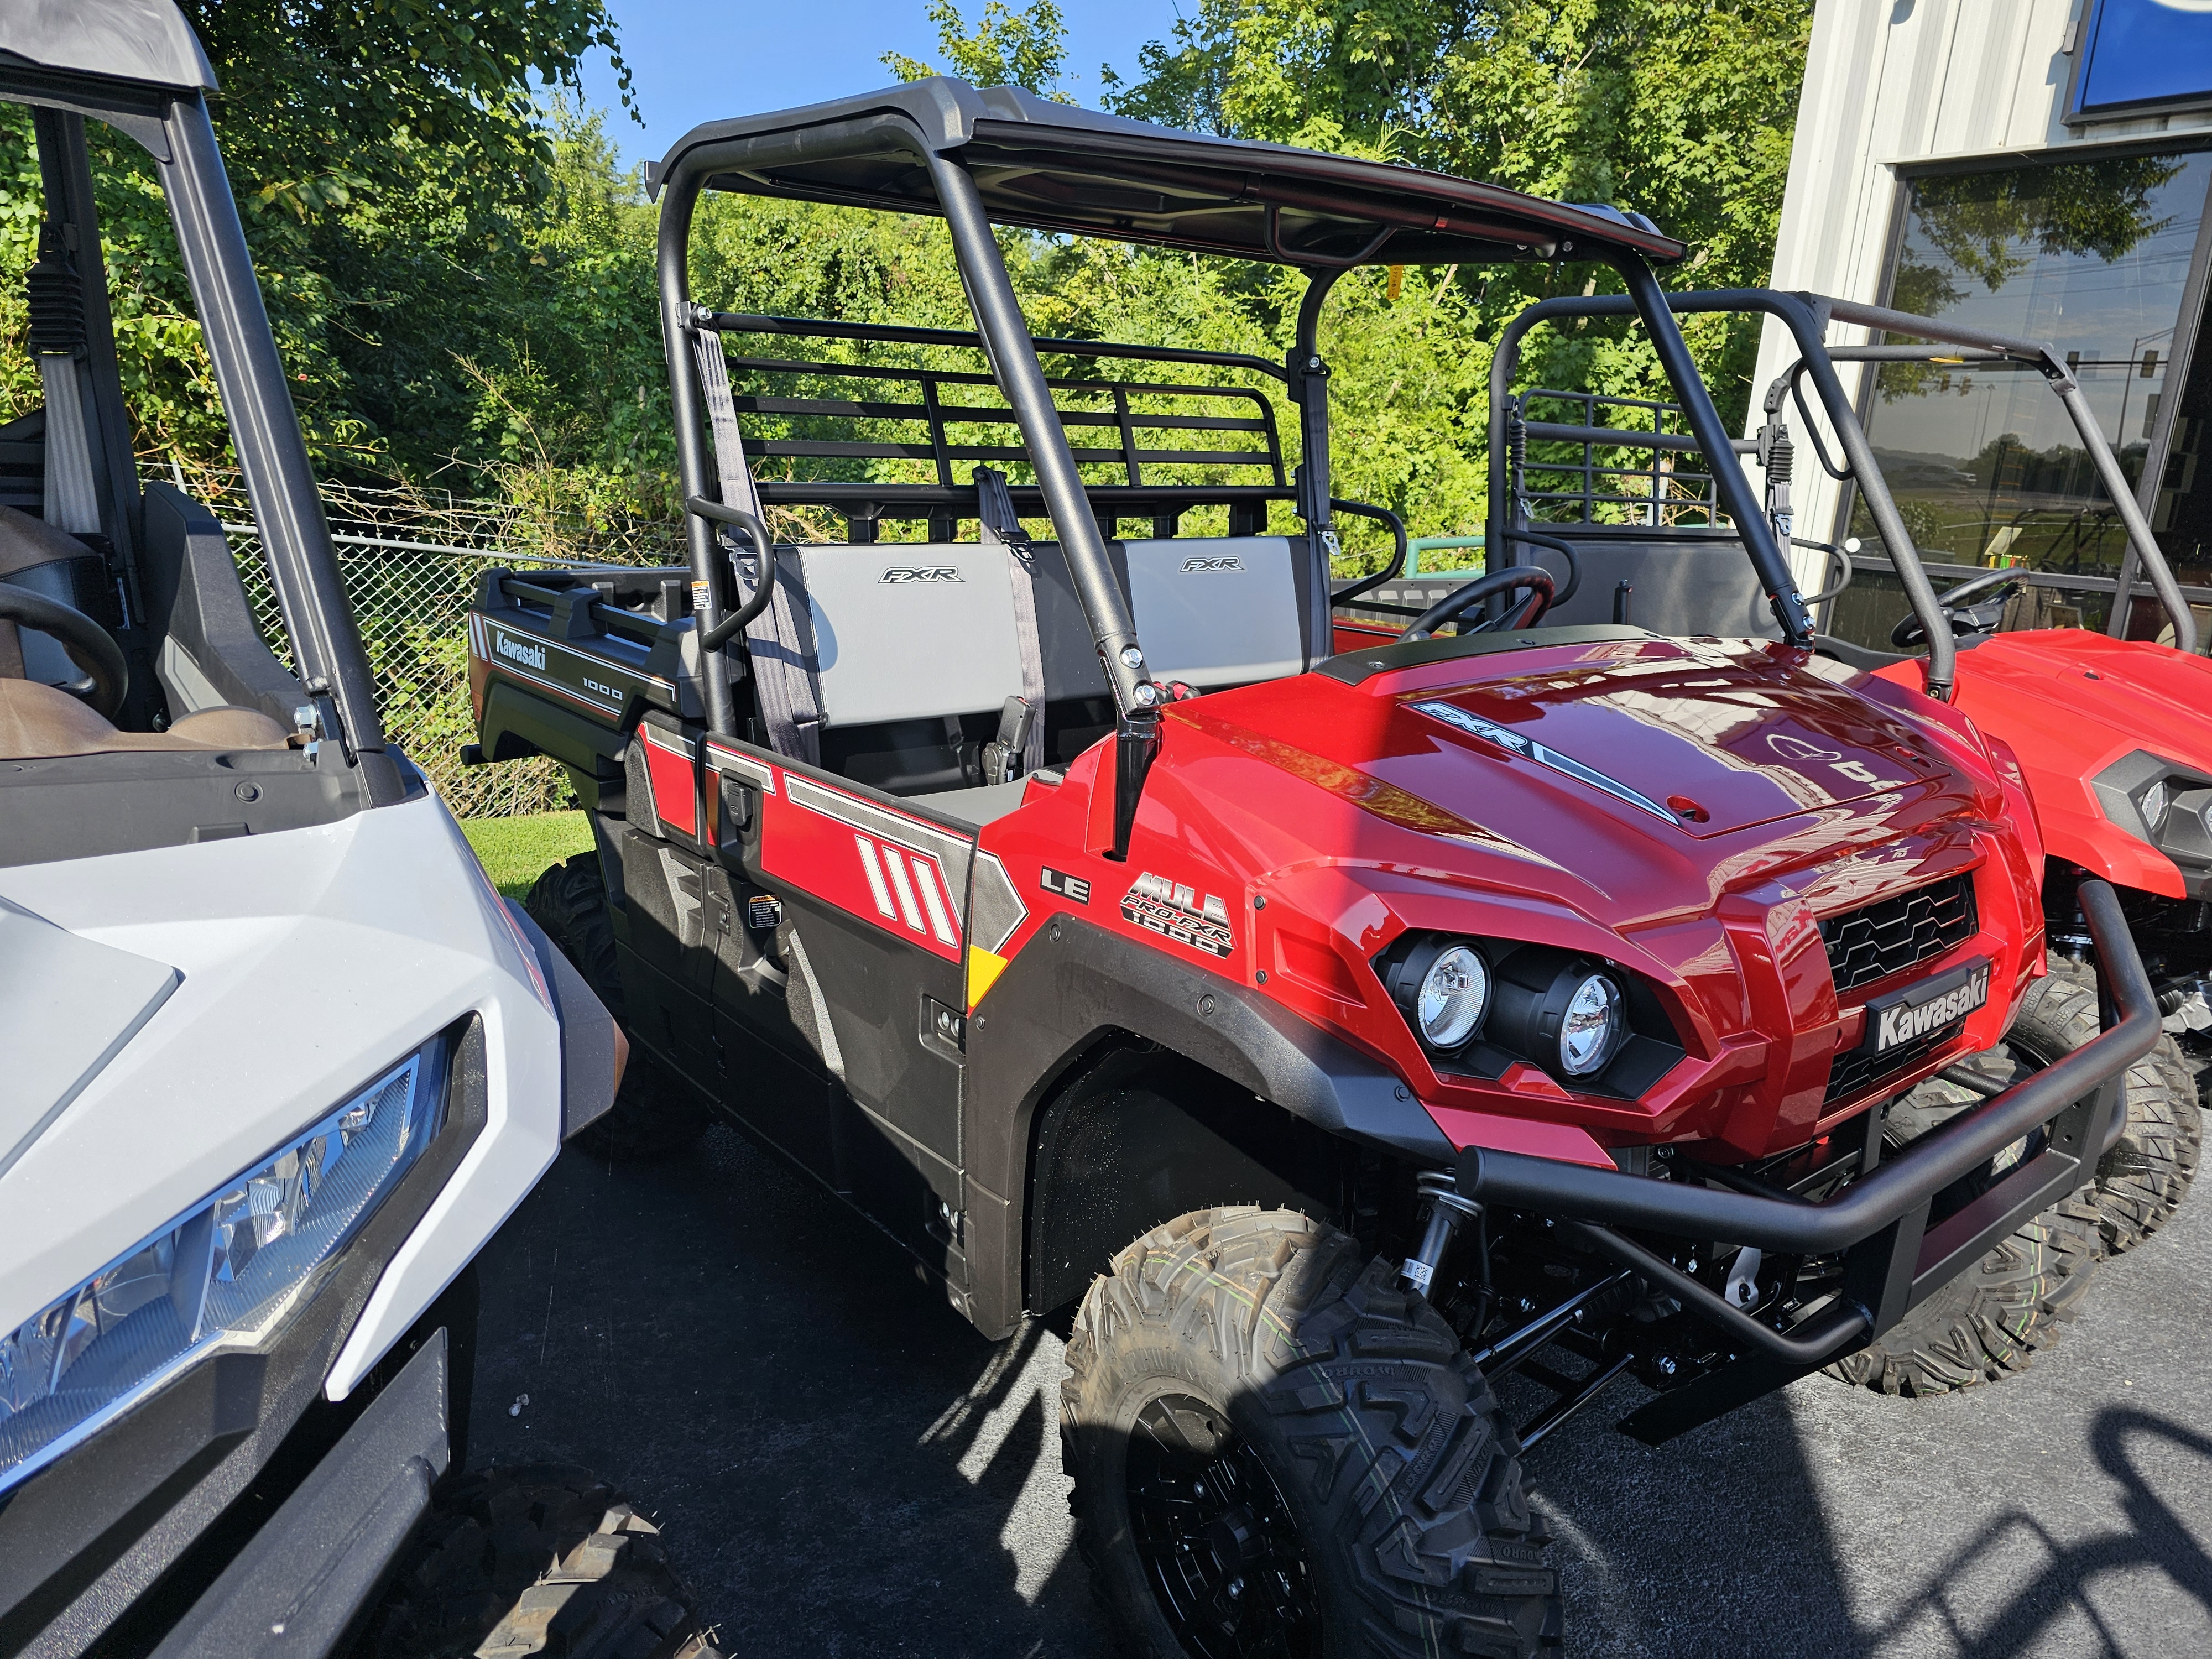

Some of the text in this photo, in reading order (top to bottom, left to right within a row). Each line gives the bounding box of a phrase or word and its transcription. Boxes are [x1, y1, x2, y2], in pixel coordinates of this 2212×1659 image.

[877, 566, 966, 584] FXR
[1180, 556, 1245, 572] FXR
[497, 630, 545, 671] Kawasaki
[583, 677, 623, 700] 1000
[1413, 702, 1528, 755] FXR
[1041, 868, 1088, 901] LE
[1128, 872, 1230, 930] MULE
[1120, 895, 1234, 947] PRO-FXR
[1132, 911, 1219, 954] 1000
[1879, 967, 1989, 1051] Kawasaki
